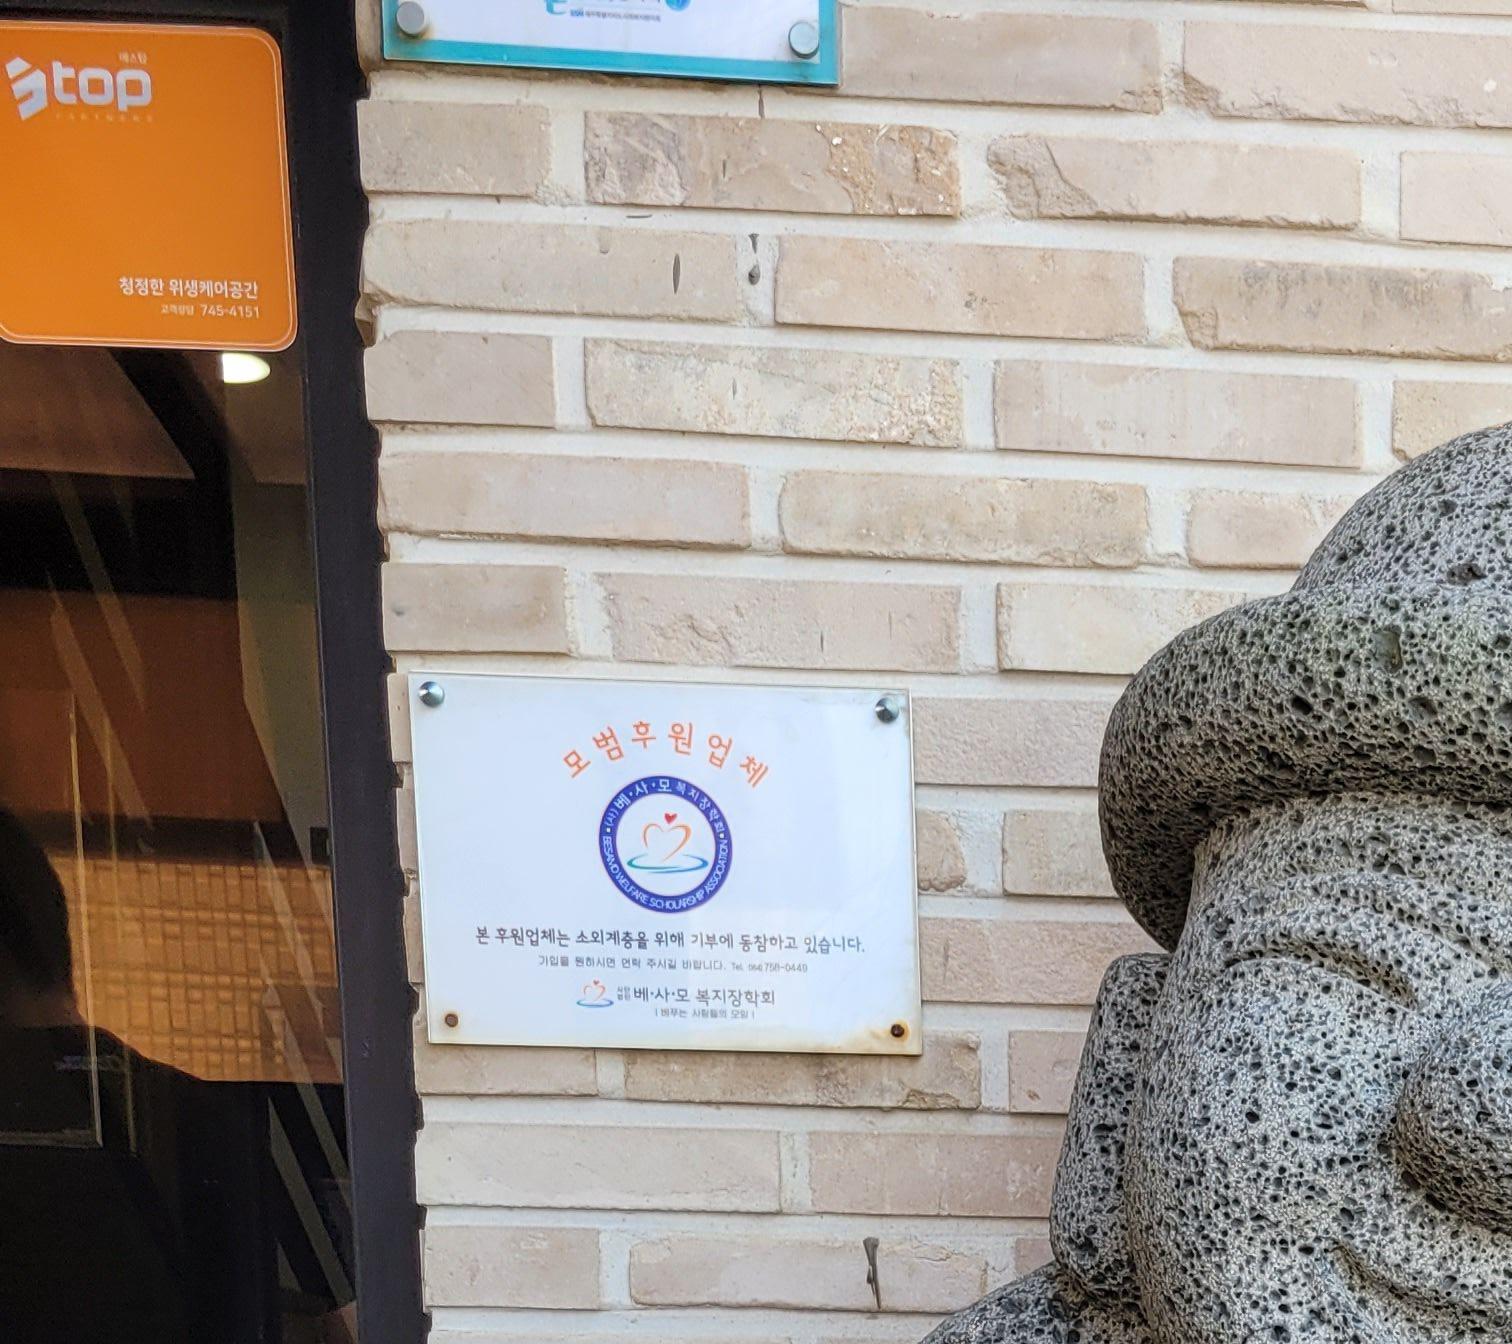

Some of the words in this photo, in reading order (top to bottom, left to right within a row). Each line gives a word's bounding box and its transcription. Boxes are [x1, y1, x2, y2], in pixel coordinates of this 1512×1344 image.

[119, 277, 164, 296] 청정한
[169, 279, 258, 300] 위생케어공간
[200, 304, 259, 318] 745-4151
[616, 873, 649, 905] WELFARE
[704, 839, 728, 894] ASSOCIATION
[475, 926, 490, 945] 본
[495, 927, 571, 948] 후원업체는
[575, 930, 649, 950] 소외계층을
[654, 931, 685, 948] 위해
[691, 933, 734, 950] 기부에
[739, 933, 799, 953] 동참하고
[803, 935, 866, 954] 있습니다.
[696, 989, 776, 1007] 복지장학회
